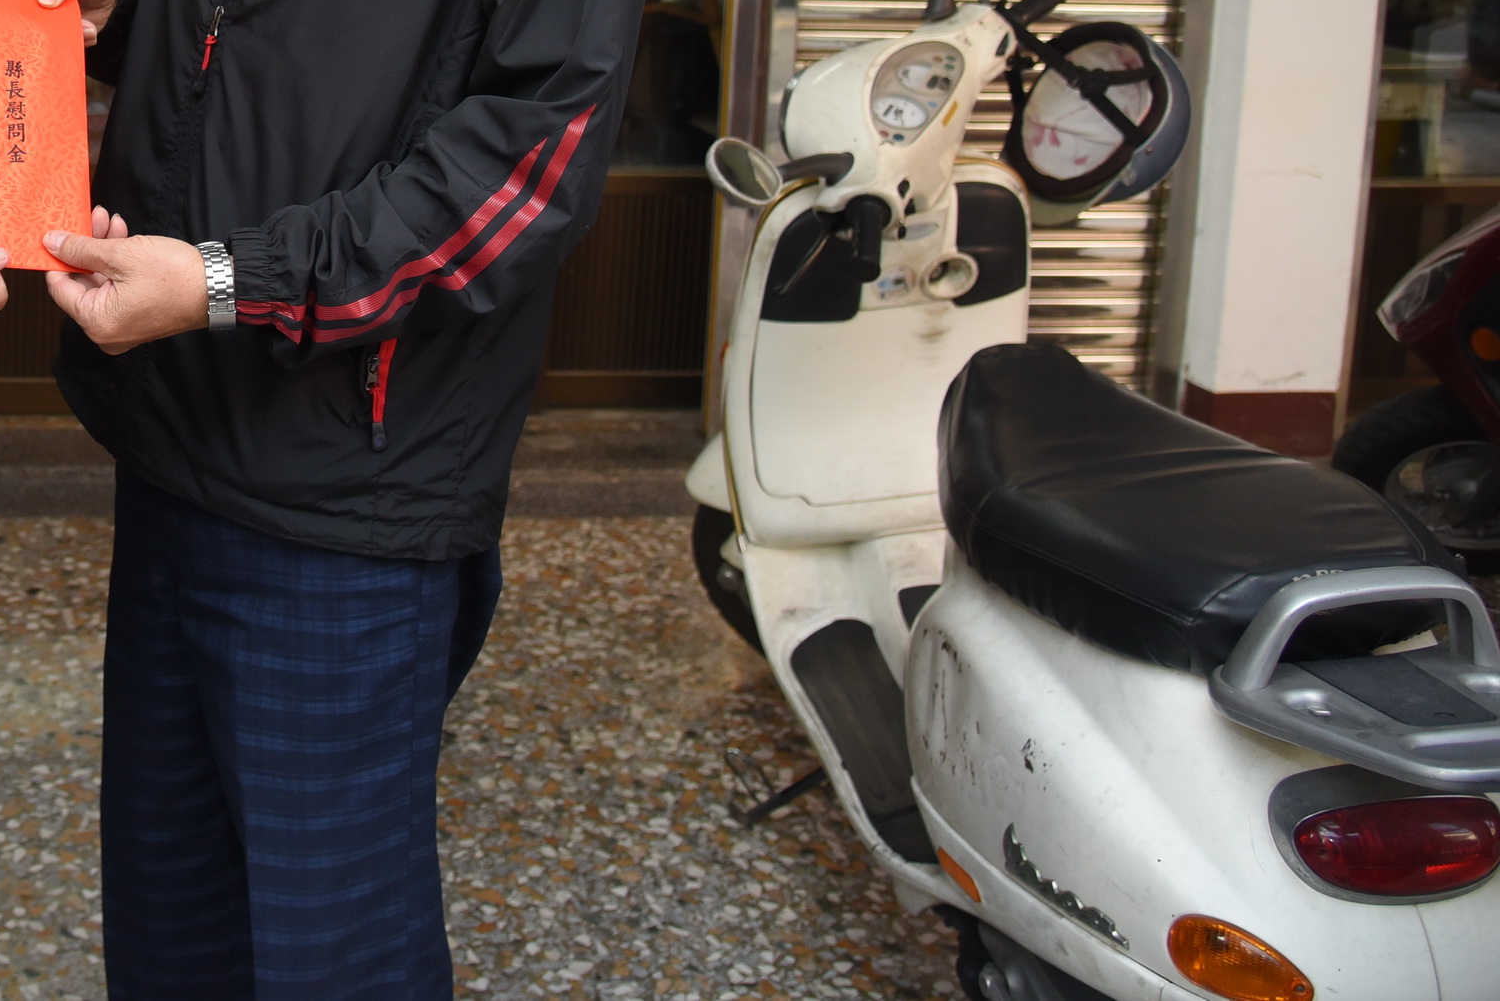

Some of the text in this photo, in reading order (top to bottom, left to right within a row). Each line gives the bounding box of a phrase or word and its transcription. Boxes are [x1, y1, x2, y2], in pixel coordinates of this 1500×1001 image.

[5, 60, 27, 163] 縣長慰問金
